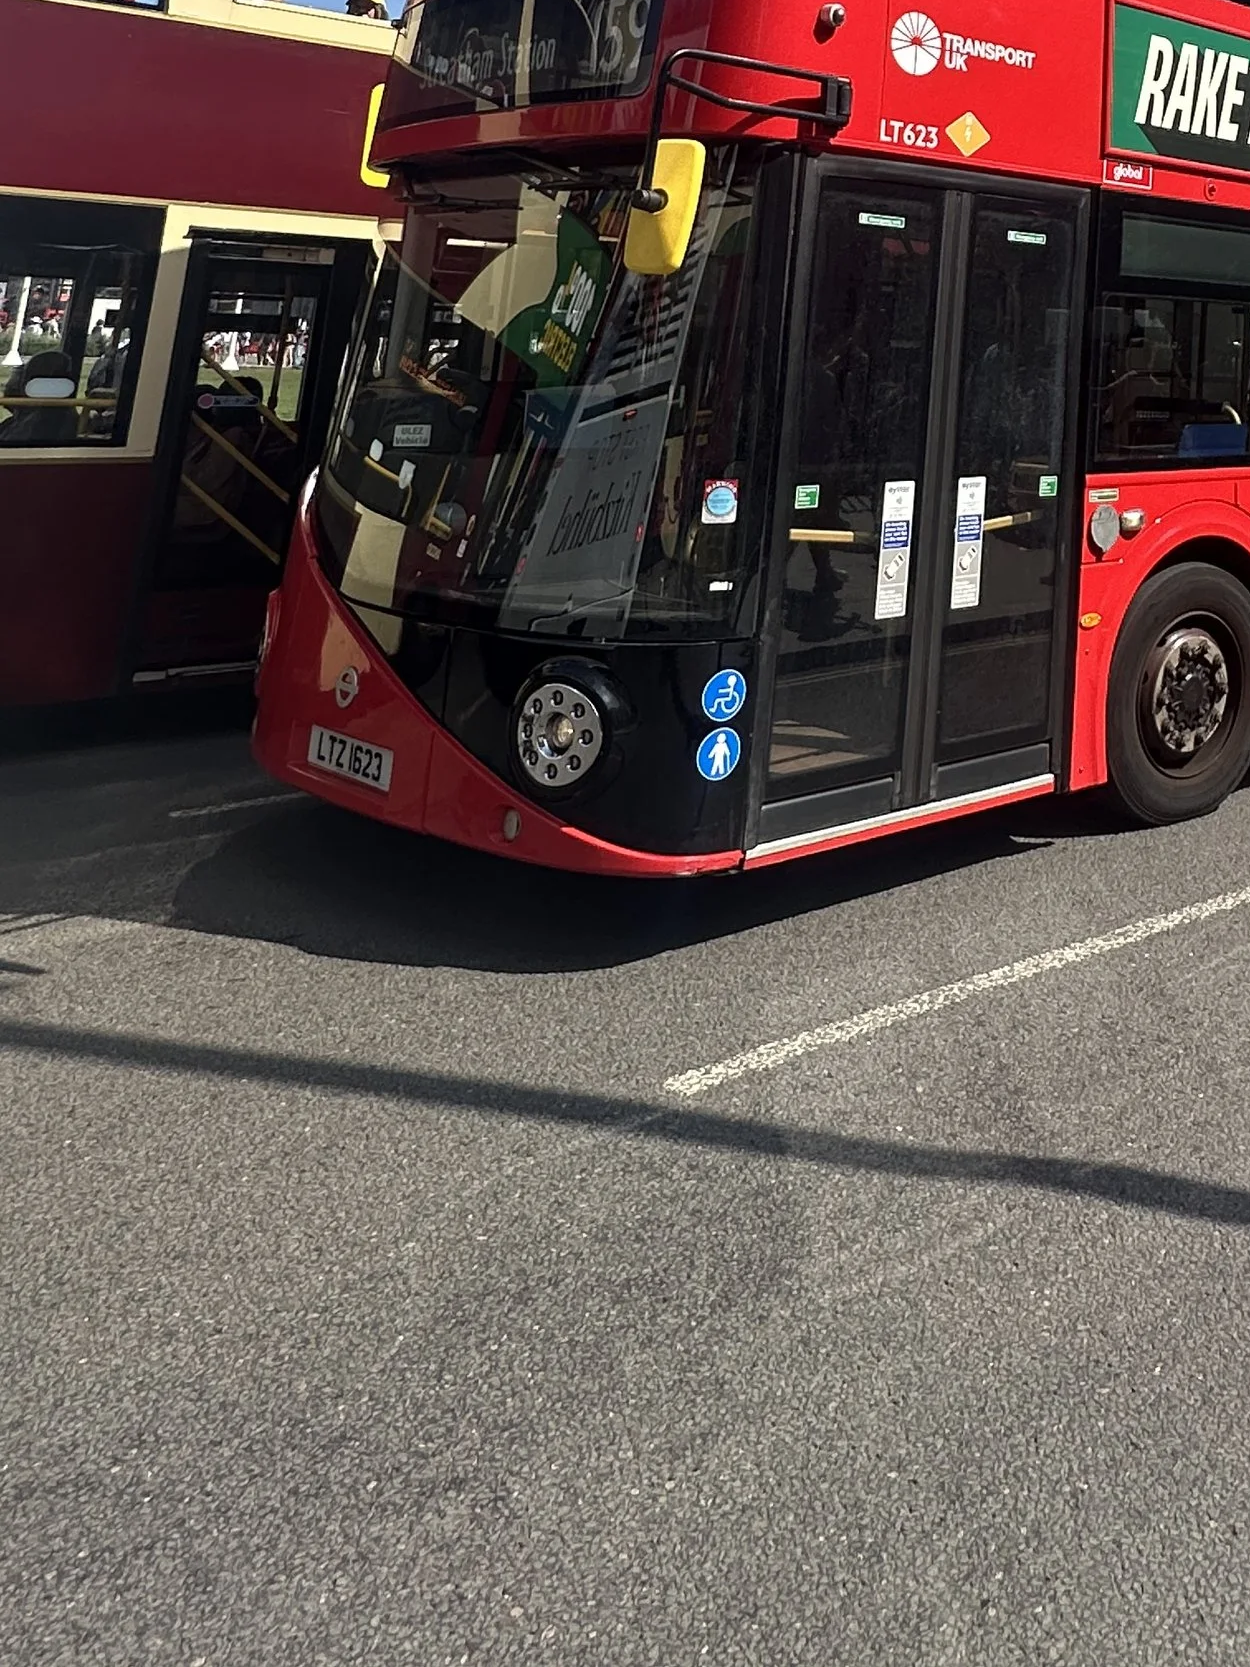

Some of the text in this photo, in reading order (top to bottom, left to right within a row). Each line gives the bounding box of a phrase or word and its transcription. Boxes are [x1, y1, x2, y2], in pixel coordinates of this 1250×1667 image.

[497, 31, 557, 78] Station
[942, 32, 1036, 69] TRANSPORT
[944, 50, 968, 72] UK
[1134, 34, 1250, 141] RAKE
[879, 118, 939, 149] LT623
[1113, 163, 1144, 180] global
